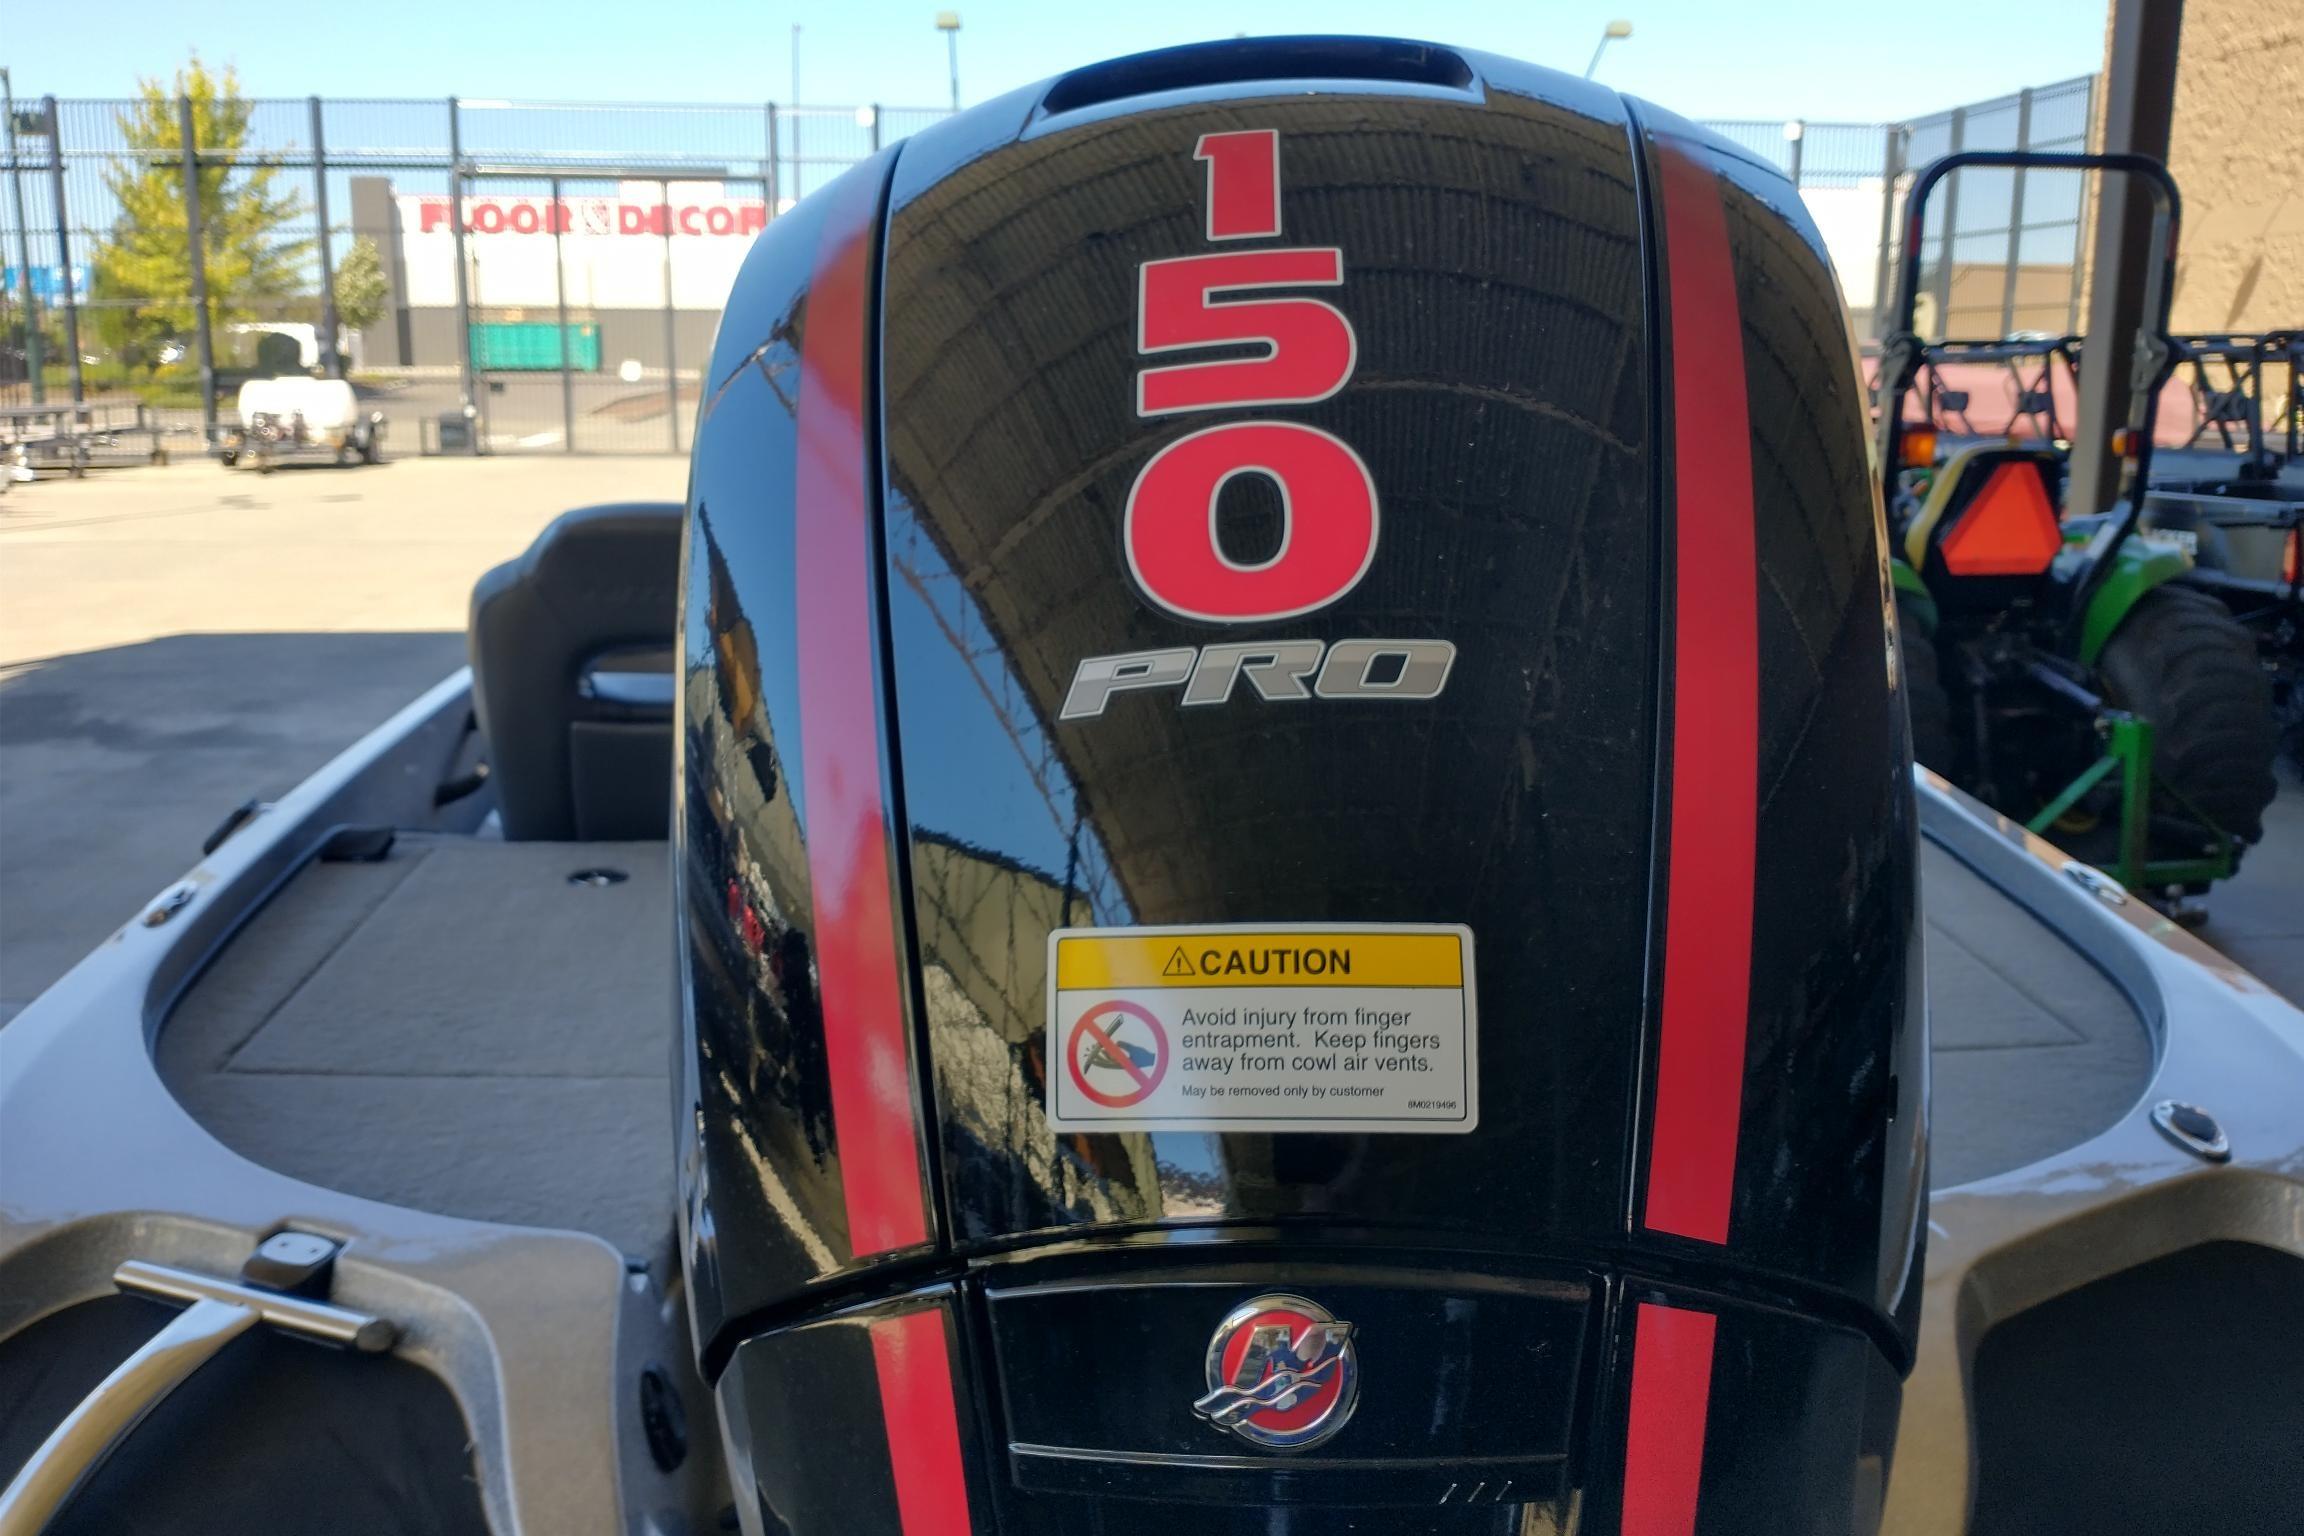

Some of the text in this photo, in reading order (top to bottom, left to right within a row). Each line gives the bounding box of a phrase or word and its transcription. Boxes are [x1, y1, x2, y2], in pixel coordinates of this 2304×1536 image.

[1123, 128, 1380, 624] 150
[1059, 639, 1456, 720] PRO
[1200, 948, 1351, 976] CAUTION
[1182, 1007, 1412, 1031] Avoid injury from finger
[1182, 1030, 1441, 1053] entrapment. Keep fingers
[1182, 1053, 1434, 1075] away from cowl air vents.
[1182, 1085, 1385, 1099] May be removed only by customer
